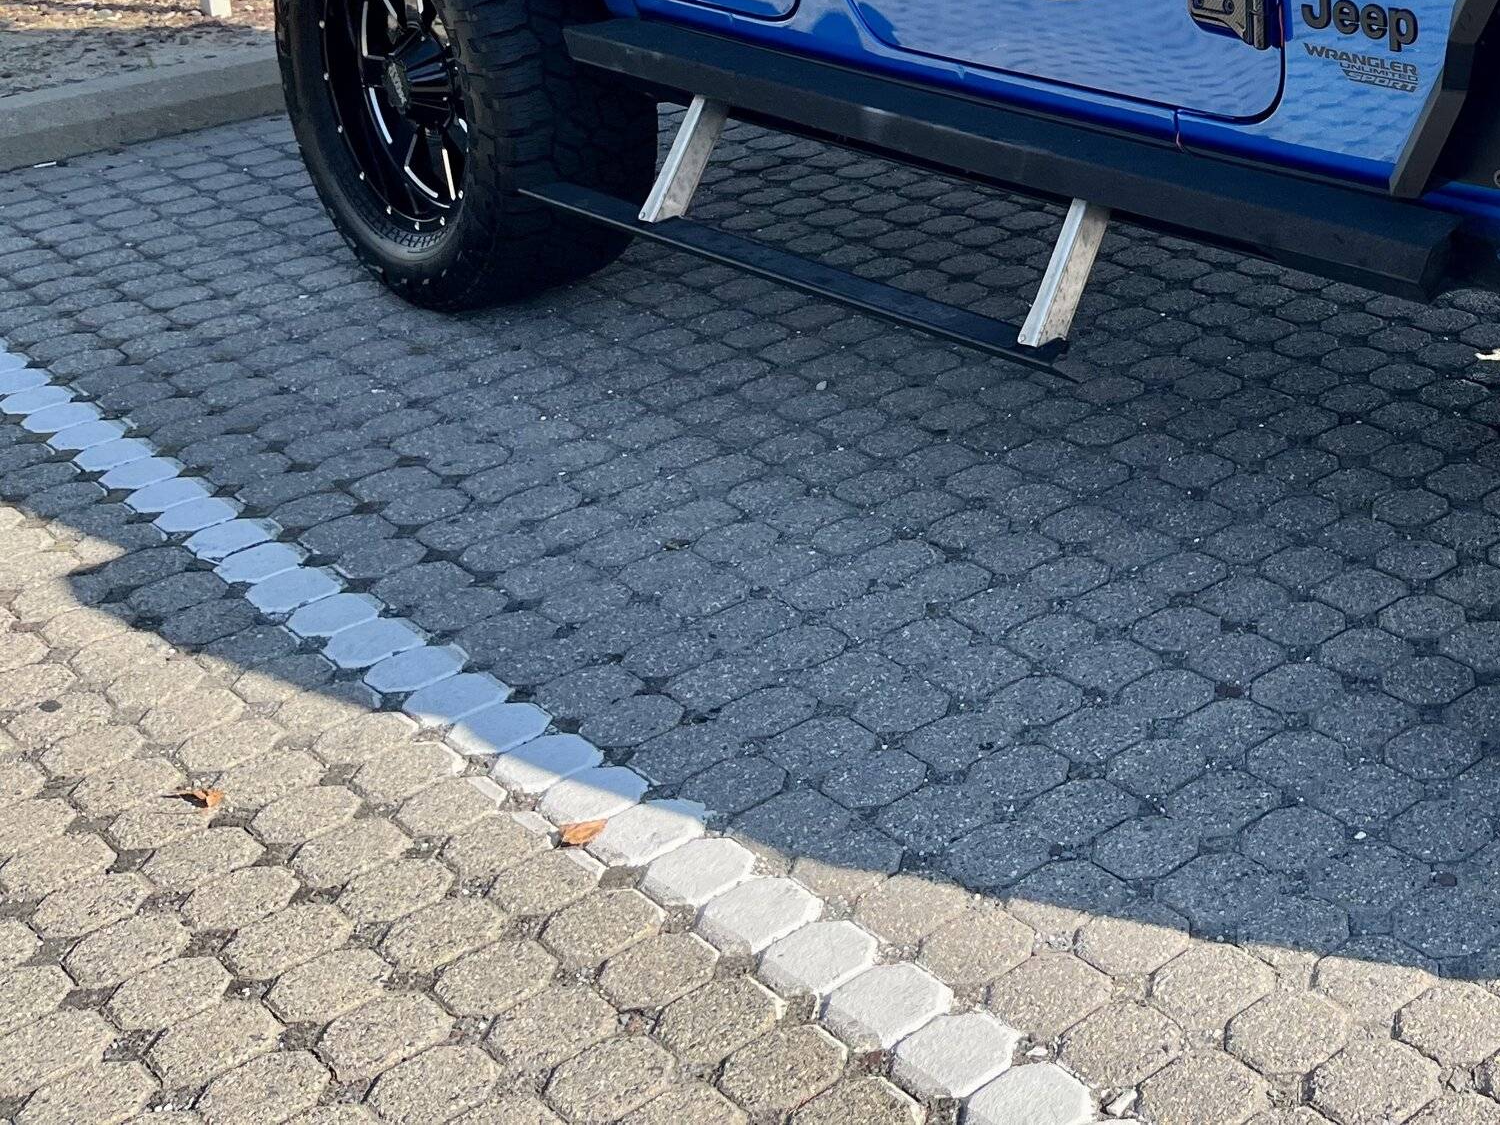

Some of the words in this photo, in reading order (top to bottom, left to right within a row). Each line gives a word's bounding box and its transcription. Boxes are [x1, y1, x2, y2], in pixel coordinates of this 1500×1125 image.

[1303, 42, 1418, 75] WRANGLER
[1340, 61, 1418, 82] UNLIMITED
[1343, 69, 1418, 92] SPORT
